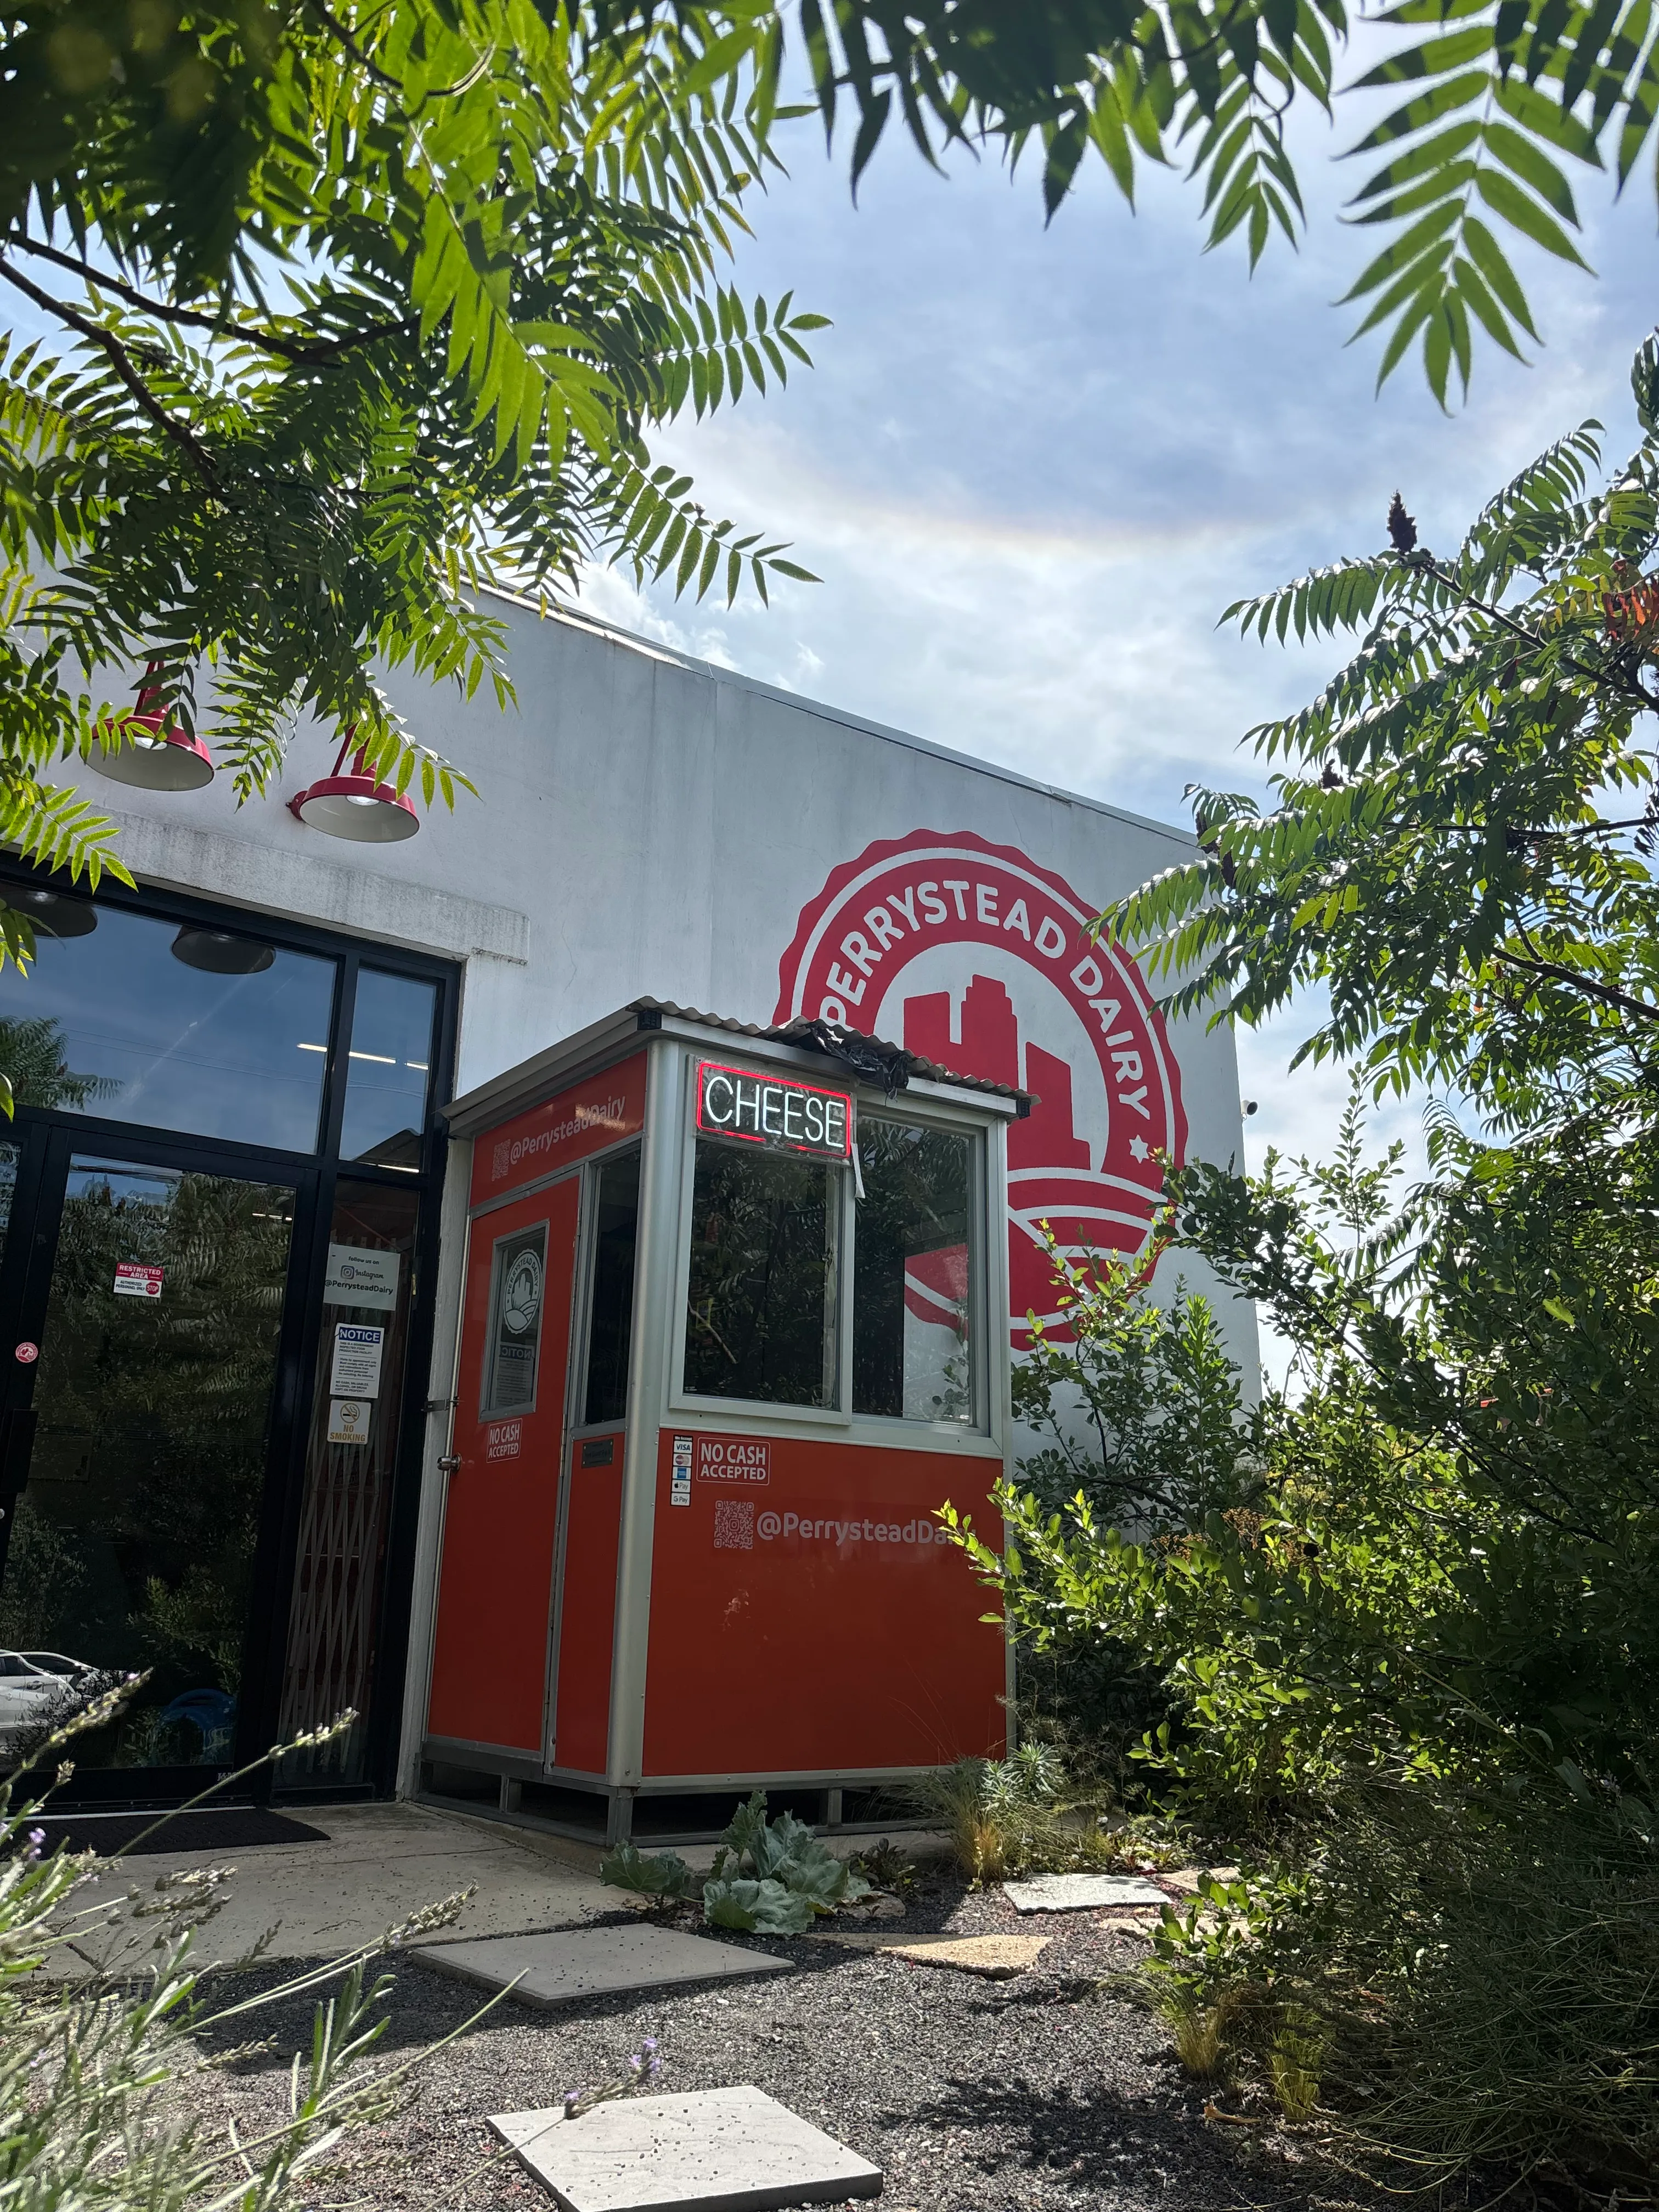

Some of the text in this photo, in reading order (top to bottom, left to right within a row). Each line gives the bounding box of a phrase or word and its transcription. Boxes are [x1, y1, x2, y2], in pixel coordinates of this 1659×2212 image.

[819, 879, 1150, 1121] PERRYSTEAD DAIRY
[705, 1076, 844, 1148] CHEESE
[510, 1095, 625, 1165] @PerrysteadDairy
[119, 1265, 161, 1276] RESTRICTED
[355, 1268, 384, 1280] Instagram
[507, 1257, 532, 1295] PERRYSTEAD
[324, 1279, 393, 1295] @PerrysteadDairy
[340, 1329, 380, 1342] NOTICE
[330, 1432, 365, 1442] SMOKING
[489, 1423, 520, 1445] NO CASH
[488, 1442, 518, 1458] ACCEPTED
[700, 1442, 766, 1466] NO CASH
[700, 1464, 766, 1481] ACCEPTED
[679, 1482, 689, 1491] Pay
